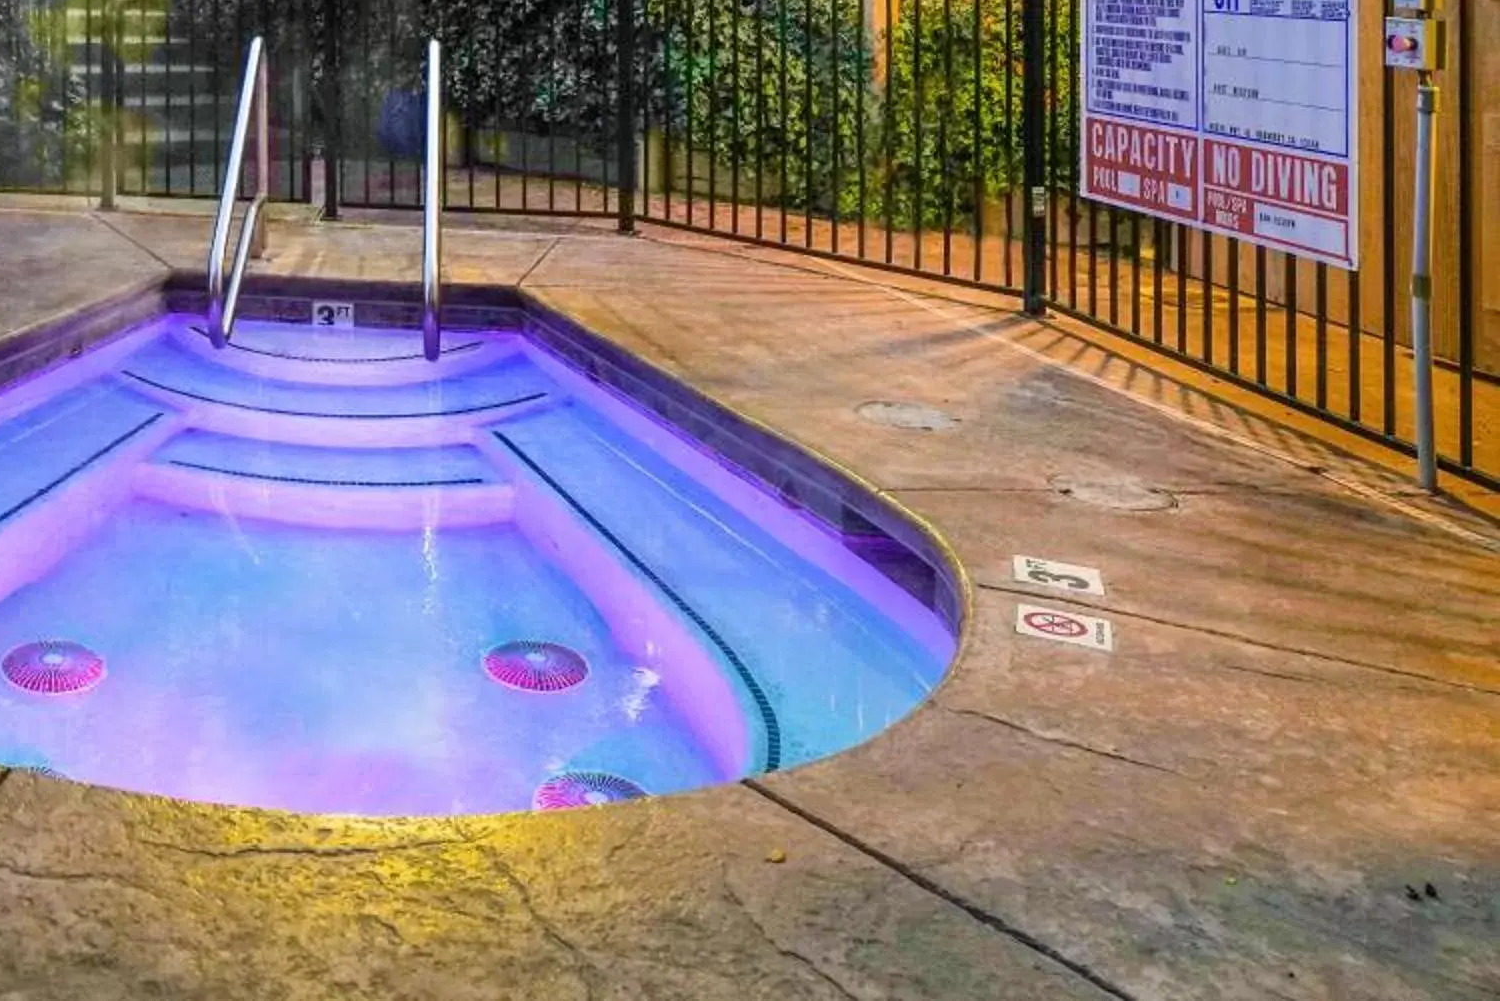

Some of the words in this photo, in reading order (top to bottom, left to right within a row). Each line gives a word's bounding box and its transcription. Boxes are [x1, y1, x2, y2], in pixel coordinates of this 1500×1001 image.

[1092, 122, 1195, 179] CAPACITY
[1212, 143, 1240, 187] NO
[1251, 150, 1337, 210] DIVING
[1093, 166, 1117, 192] POOL
[1143, 177, 1165, 204] SPA
